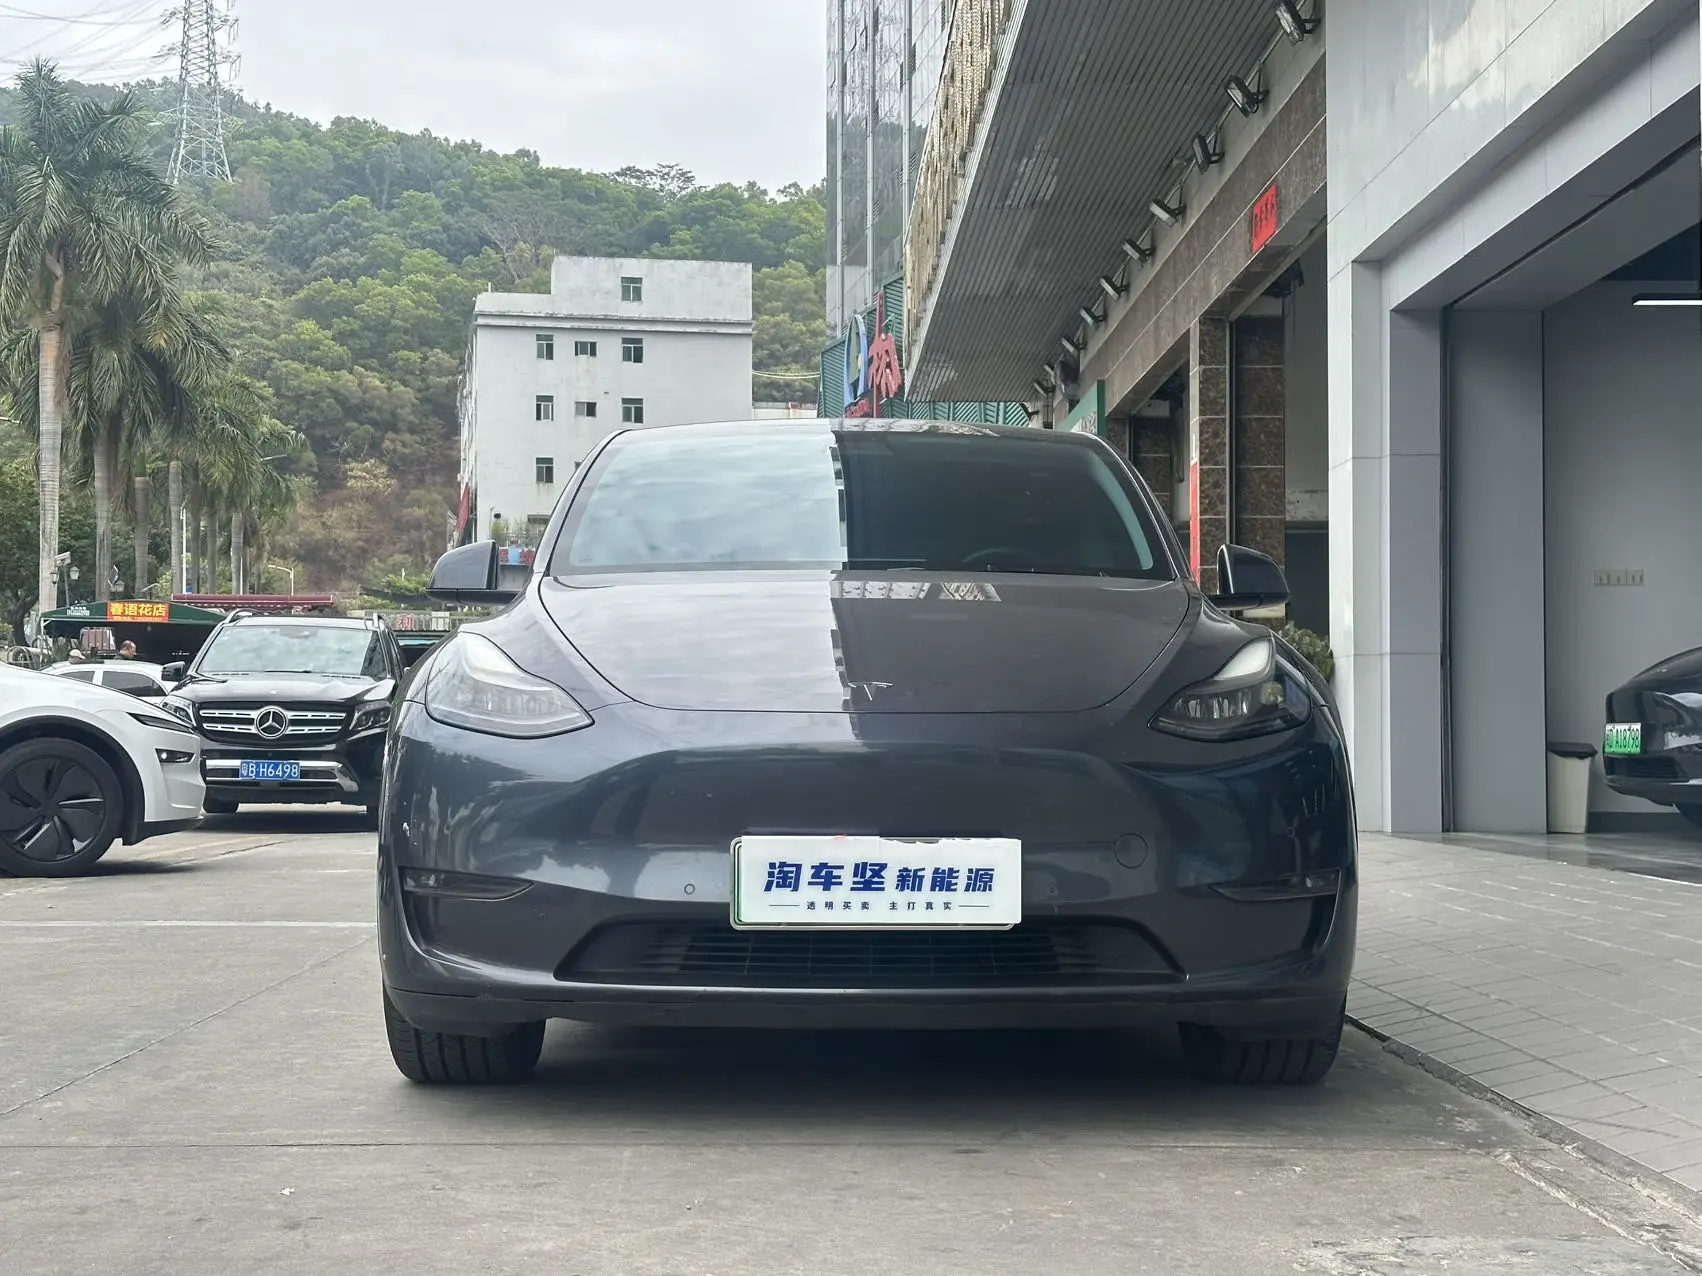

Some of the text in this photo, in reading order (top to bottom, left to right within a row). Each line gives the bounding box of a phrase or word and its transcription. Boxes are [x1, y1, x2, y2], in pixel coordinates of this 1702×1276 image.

[110, 602, 168, 617] 春语花店
[806, 901, 952, 911] 透明买卖 主打真实
